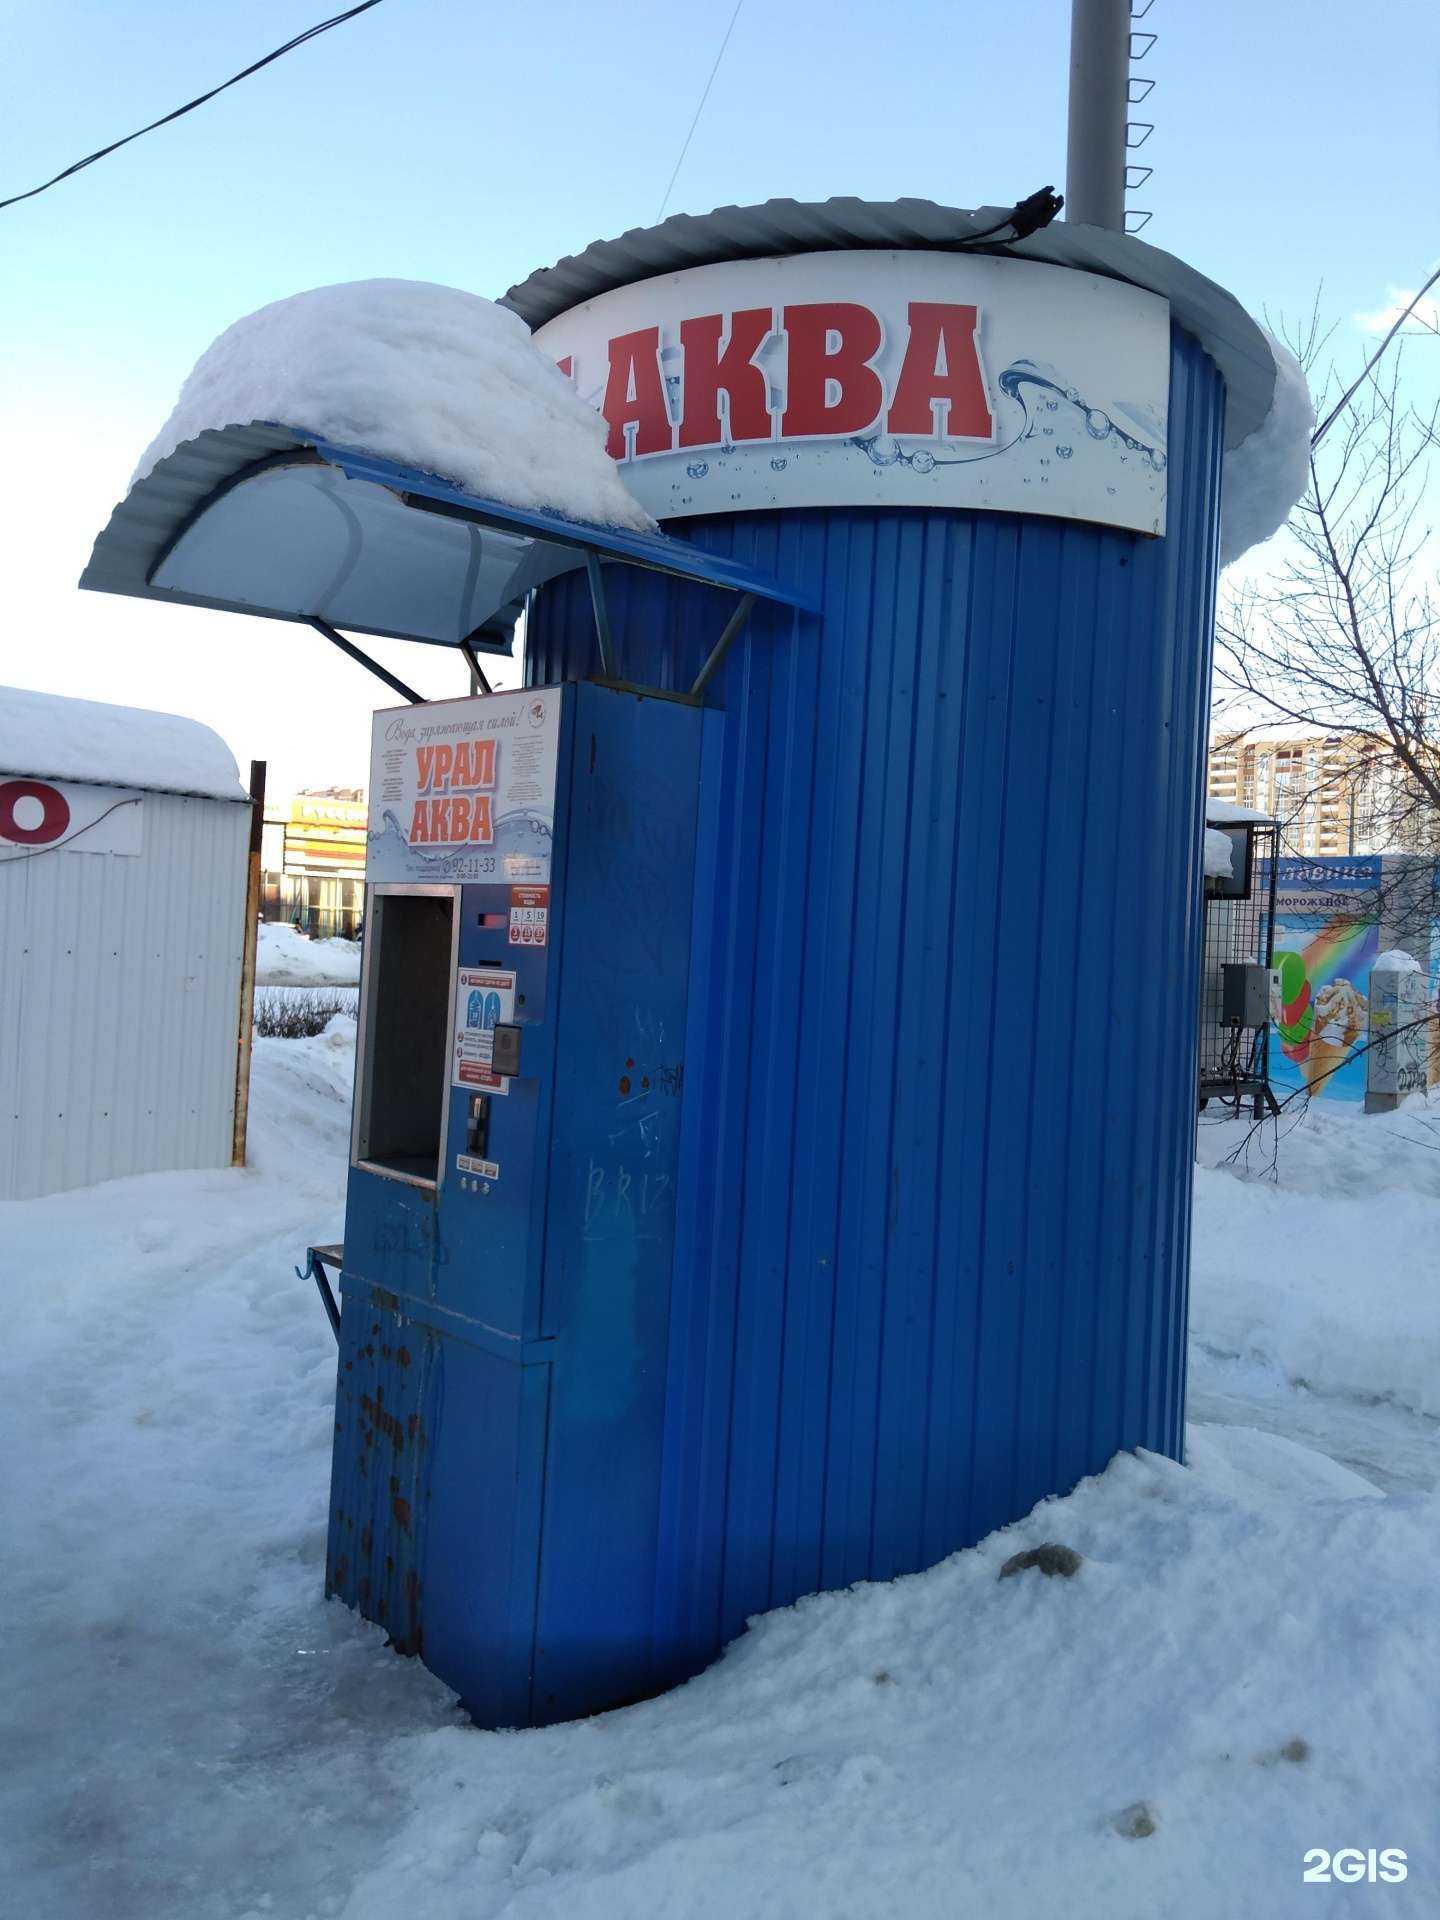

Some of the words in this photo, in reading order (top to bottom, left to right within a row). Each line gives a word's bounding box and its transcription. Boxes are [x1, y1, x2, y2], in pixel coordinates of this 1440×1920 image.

[601, 302, 996, 460] АКВА
[415, 740, 496, 790] УРАЛ
[409, 796, 492, 843] АКВА
[453, 857, 496, 873] 92-11-33
